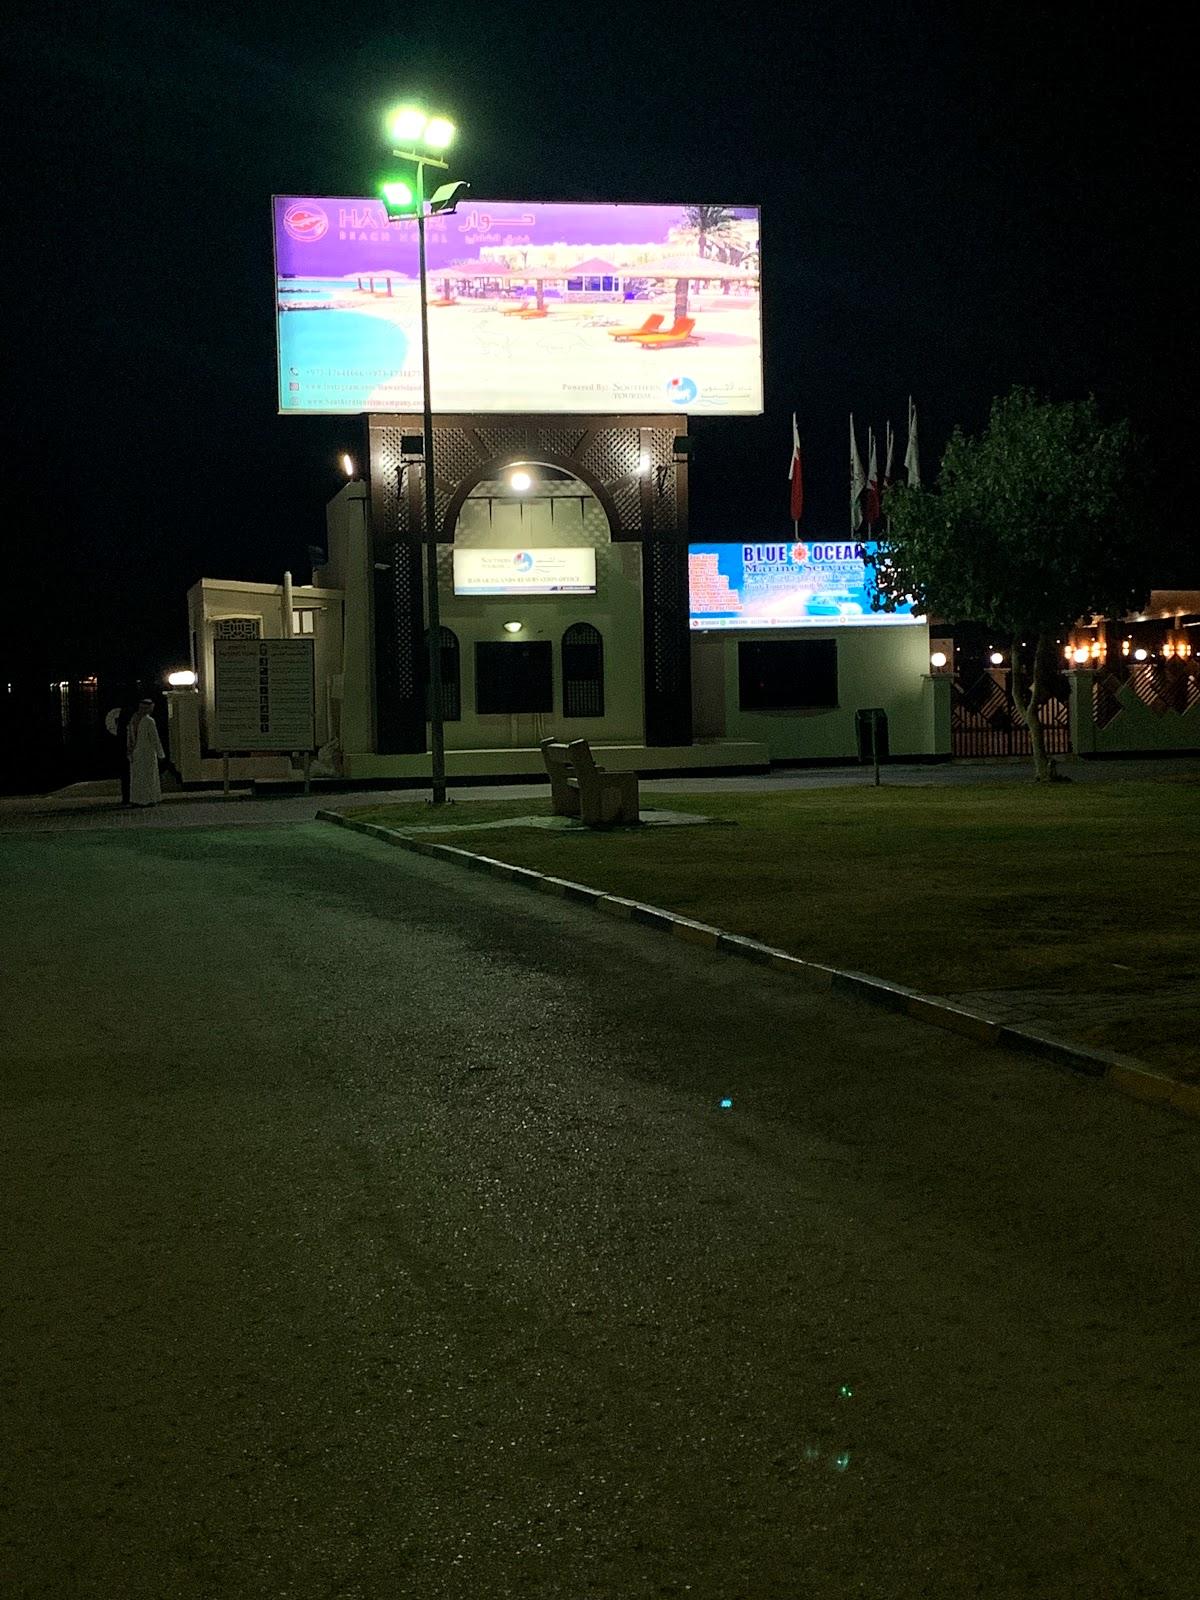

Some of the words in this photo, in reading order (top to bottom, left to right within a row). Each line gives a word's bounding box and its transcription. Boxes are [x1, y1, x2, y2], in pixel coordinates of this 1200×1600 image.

[743, 546, 787, 562] BLUE
[813, 544, 866, 561] OCEAN
[745, 564, 798, 573] Marine
[803, 564, 864, 572] Services
